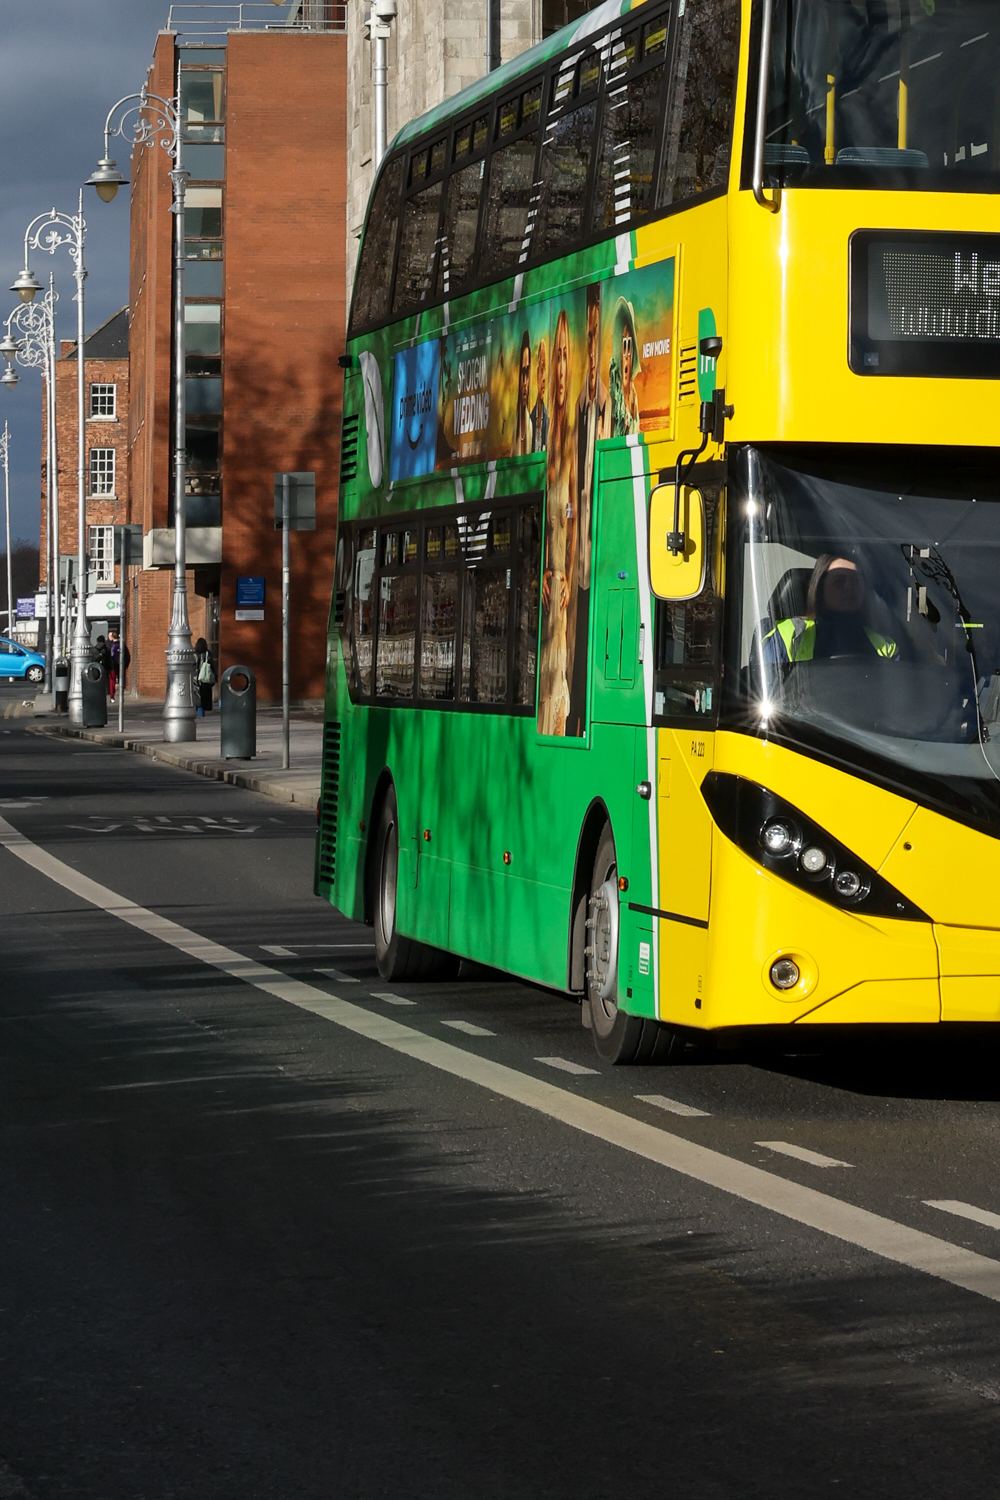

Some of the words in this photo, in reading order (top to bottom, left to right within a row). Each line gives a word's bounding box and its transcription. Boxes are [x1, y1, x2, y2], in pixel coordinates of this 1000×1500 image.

[642, 341, 654, 358] NEW
[654, 338, 671, 356] MOVIE
[457, 355, 488, 394] SHOTGUN
[453, 391, 490, 436] WEDDING
[691, 740, 697, 756] PA
